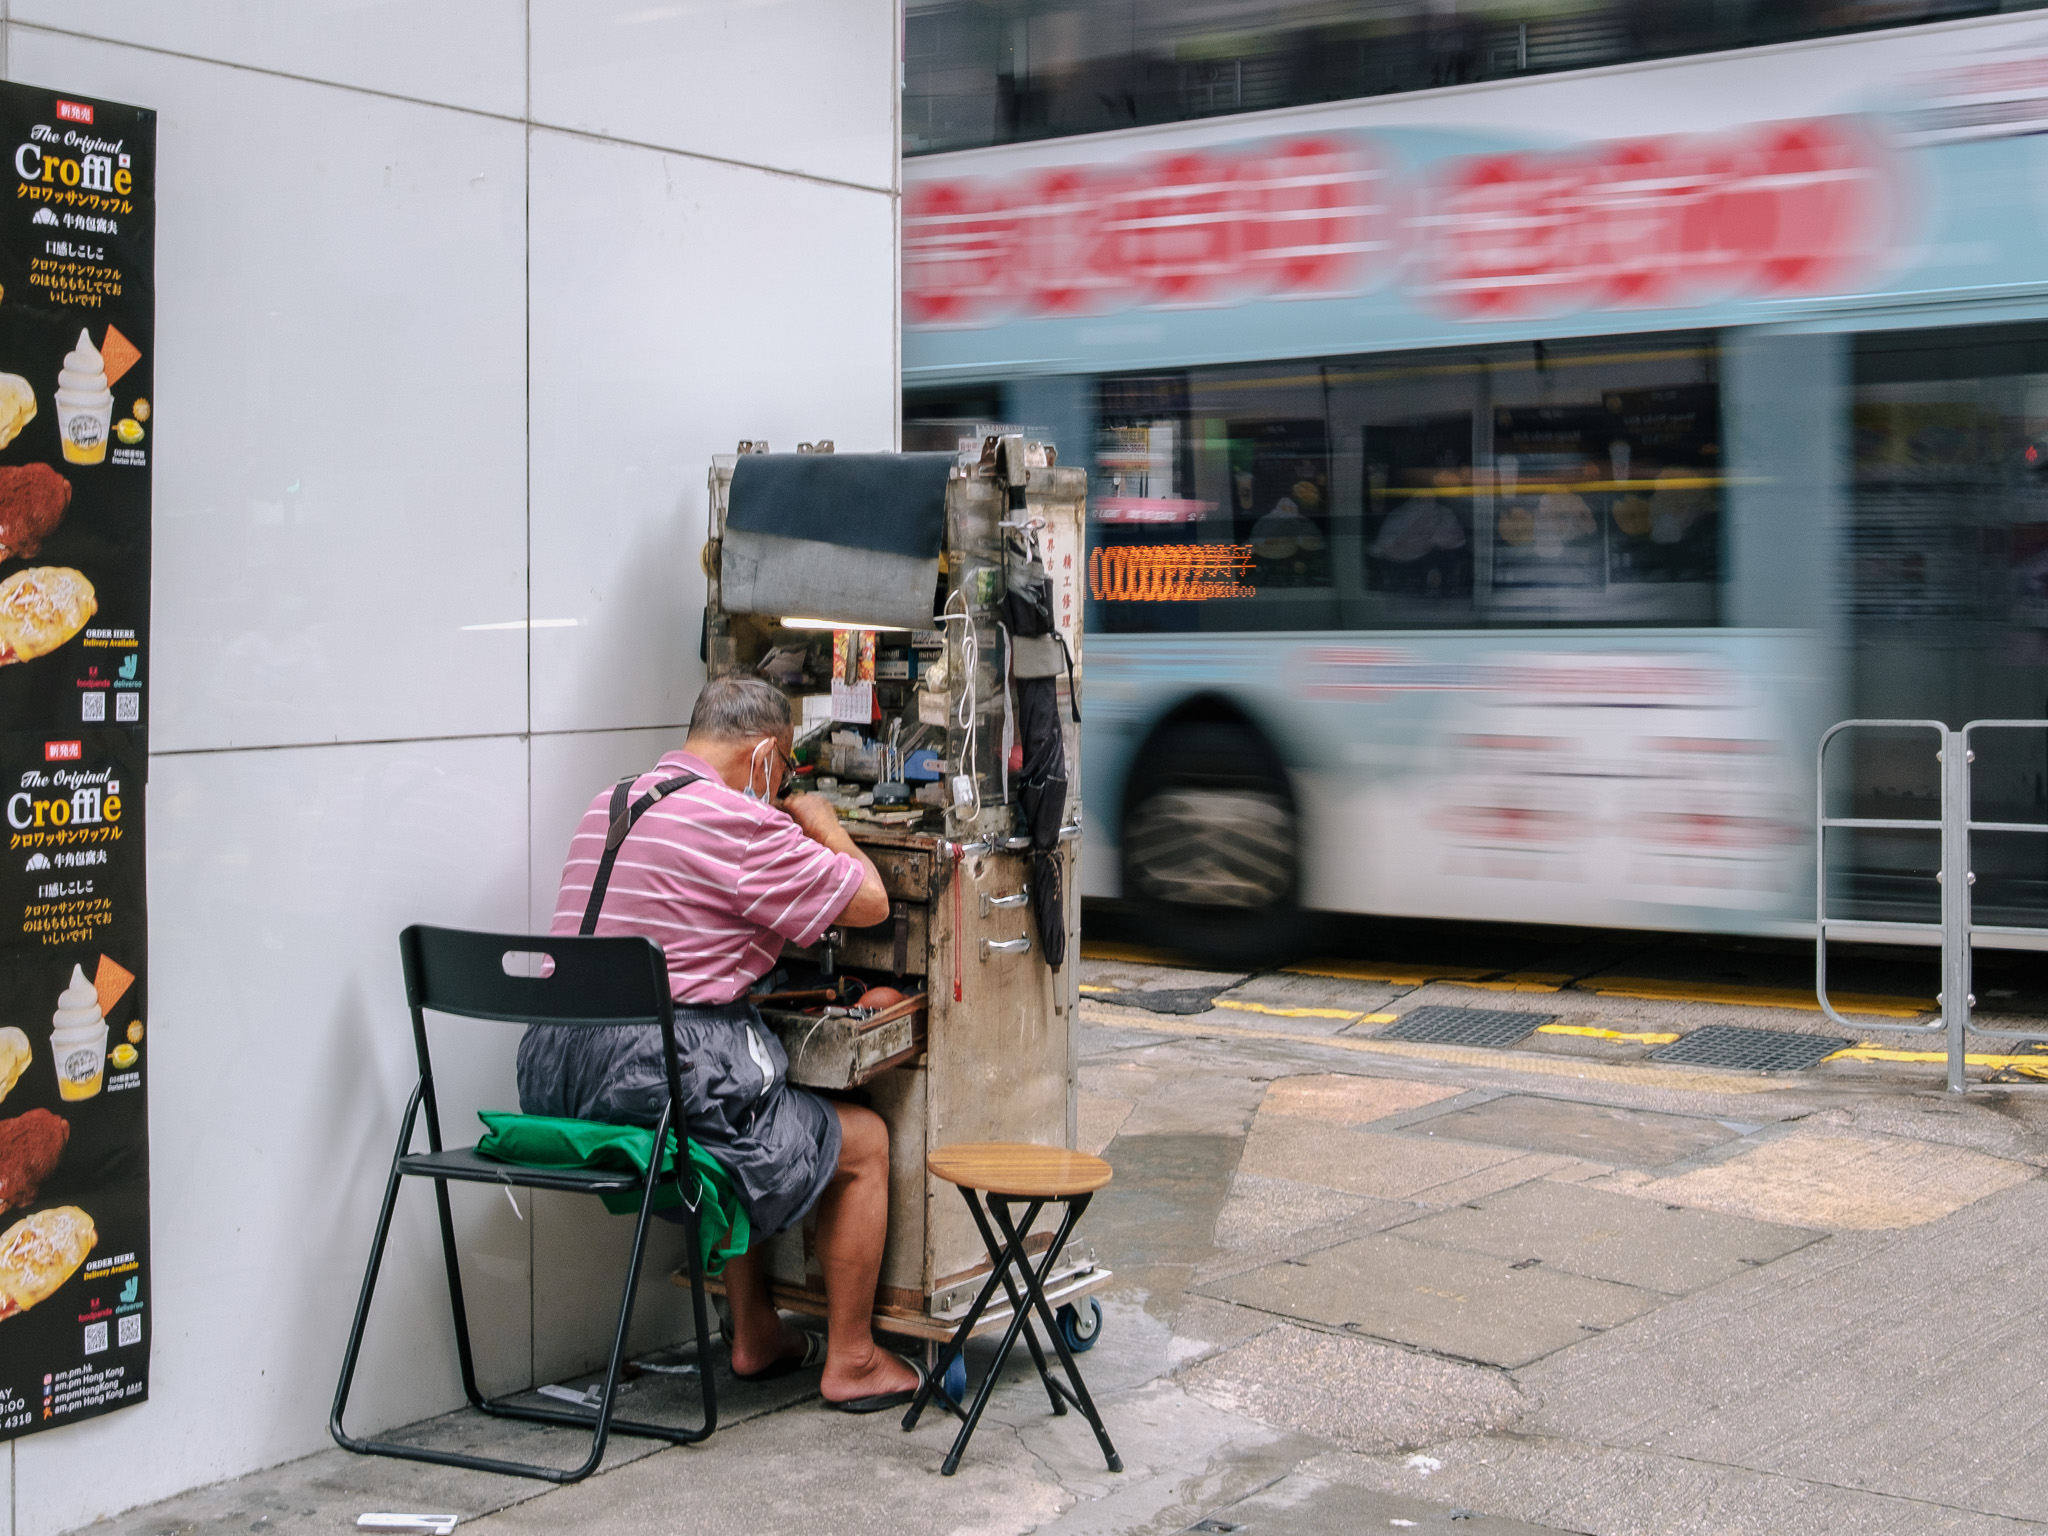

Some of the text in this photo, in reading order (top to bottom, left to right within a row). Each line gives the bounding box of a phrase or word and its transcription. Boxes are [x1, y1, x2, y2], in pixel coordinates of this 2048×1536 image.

[30, 124, 124, 154] The Original
[15, 142, 132, 195] Croffle
[17, 182, 133, 214] クロワッサンワッフル
[31, 257, 122, 280] クロワッサンワッフル
[1062, 553, 1072, 628] 精工修理
[86, 629, 135, 639] ORDER HERE
[20, 766, 112, 790] The Original
[7, 787, 122, 830] Croffle
[10, 825, 123, 850] クロワッサンワッフル
[24, 897, 112, 919] クロワッサンワッフル
[86, 1252, 135, 1271] ORDER HERE
[83, 1373, 104, 1387] Hong
[105, 1366, 125, 1379] Kong
[83, 1395, 105, 1408] Hong
[105, 1388, 124, 1401] Kong
